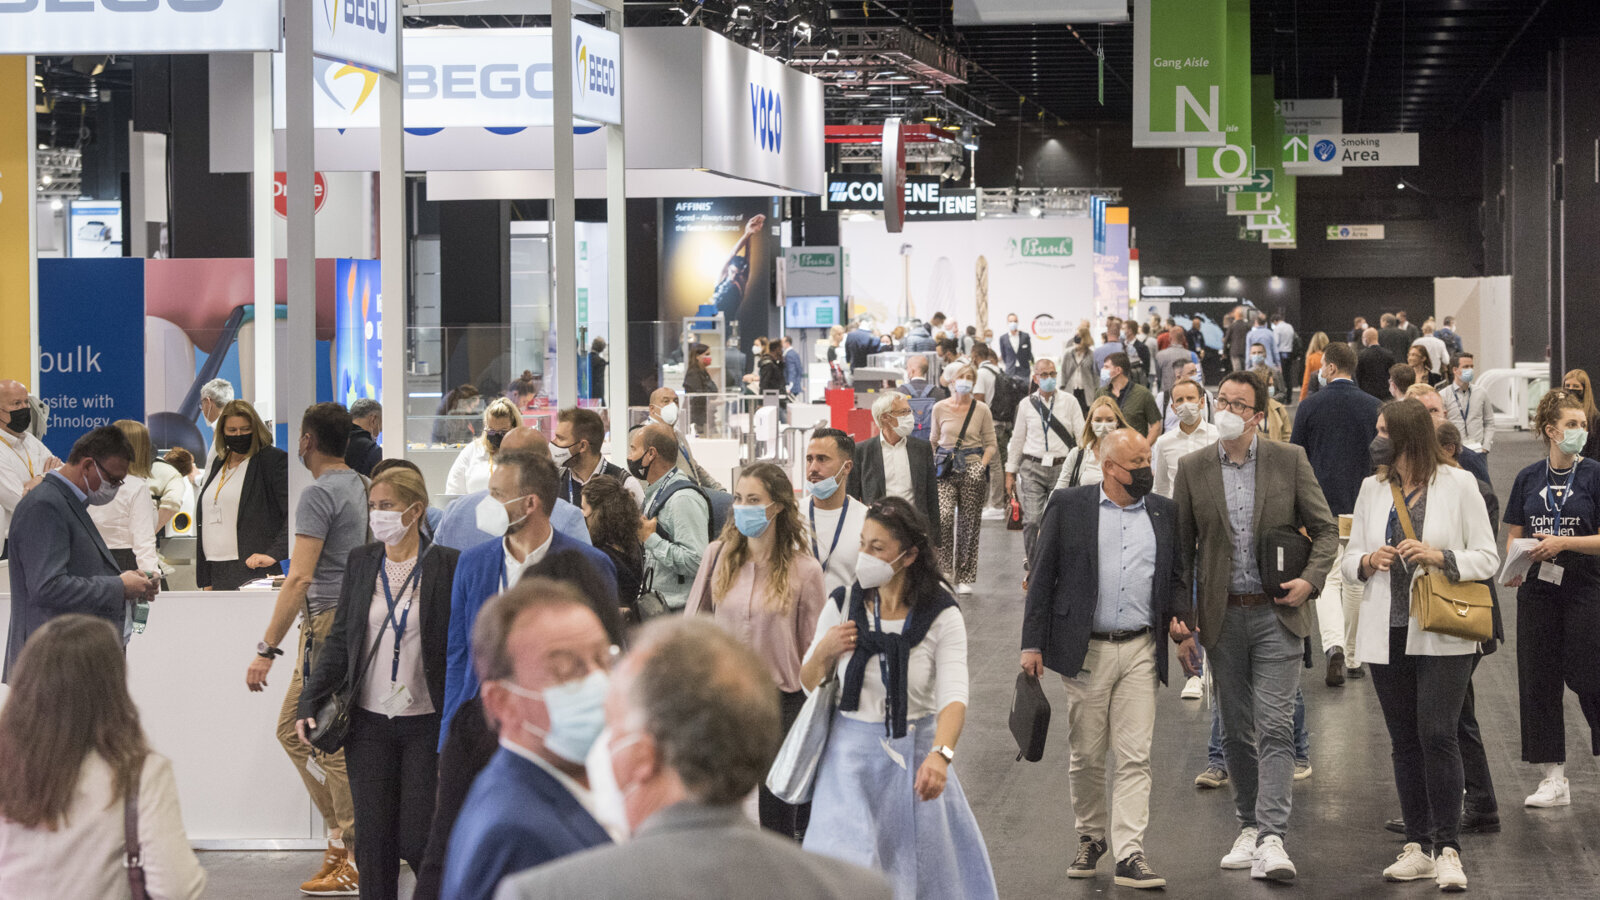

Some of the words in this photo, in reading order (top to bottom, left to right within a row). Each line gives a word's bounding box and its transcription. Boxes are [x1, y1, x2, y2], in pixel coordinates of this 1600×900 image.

[1153, 57, 1182, 70] Gang
[1184, 57, 1210, 68] Aisle
[589, 54, 615, 97] BEGO
[1175, 85, 1219, 132] N
[1284, 101, 1295, 112] 11
[1226, 124, 1239, 133] isle
[1341, 138, 1380, 147] Smoking
[1213, 144, 1248, 180] O
[1342, 149, 1380, 161] Area
[847, 181, 939, 203] COLENE
[675, 201, 712, 212] AFFINIS
[39, 345, 102, 373] bulk
[42, 394, 77, 409] osite
[83, 394, 114, 408] with
[47, 414, 110, 429] chnology
